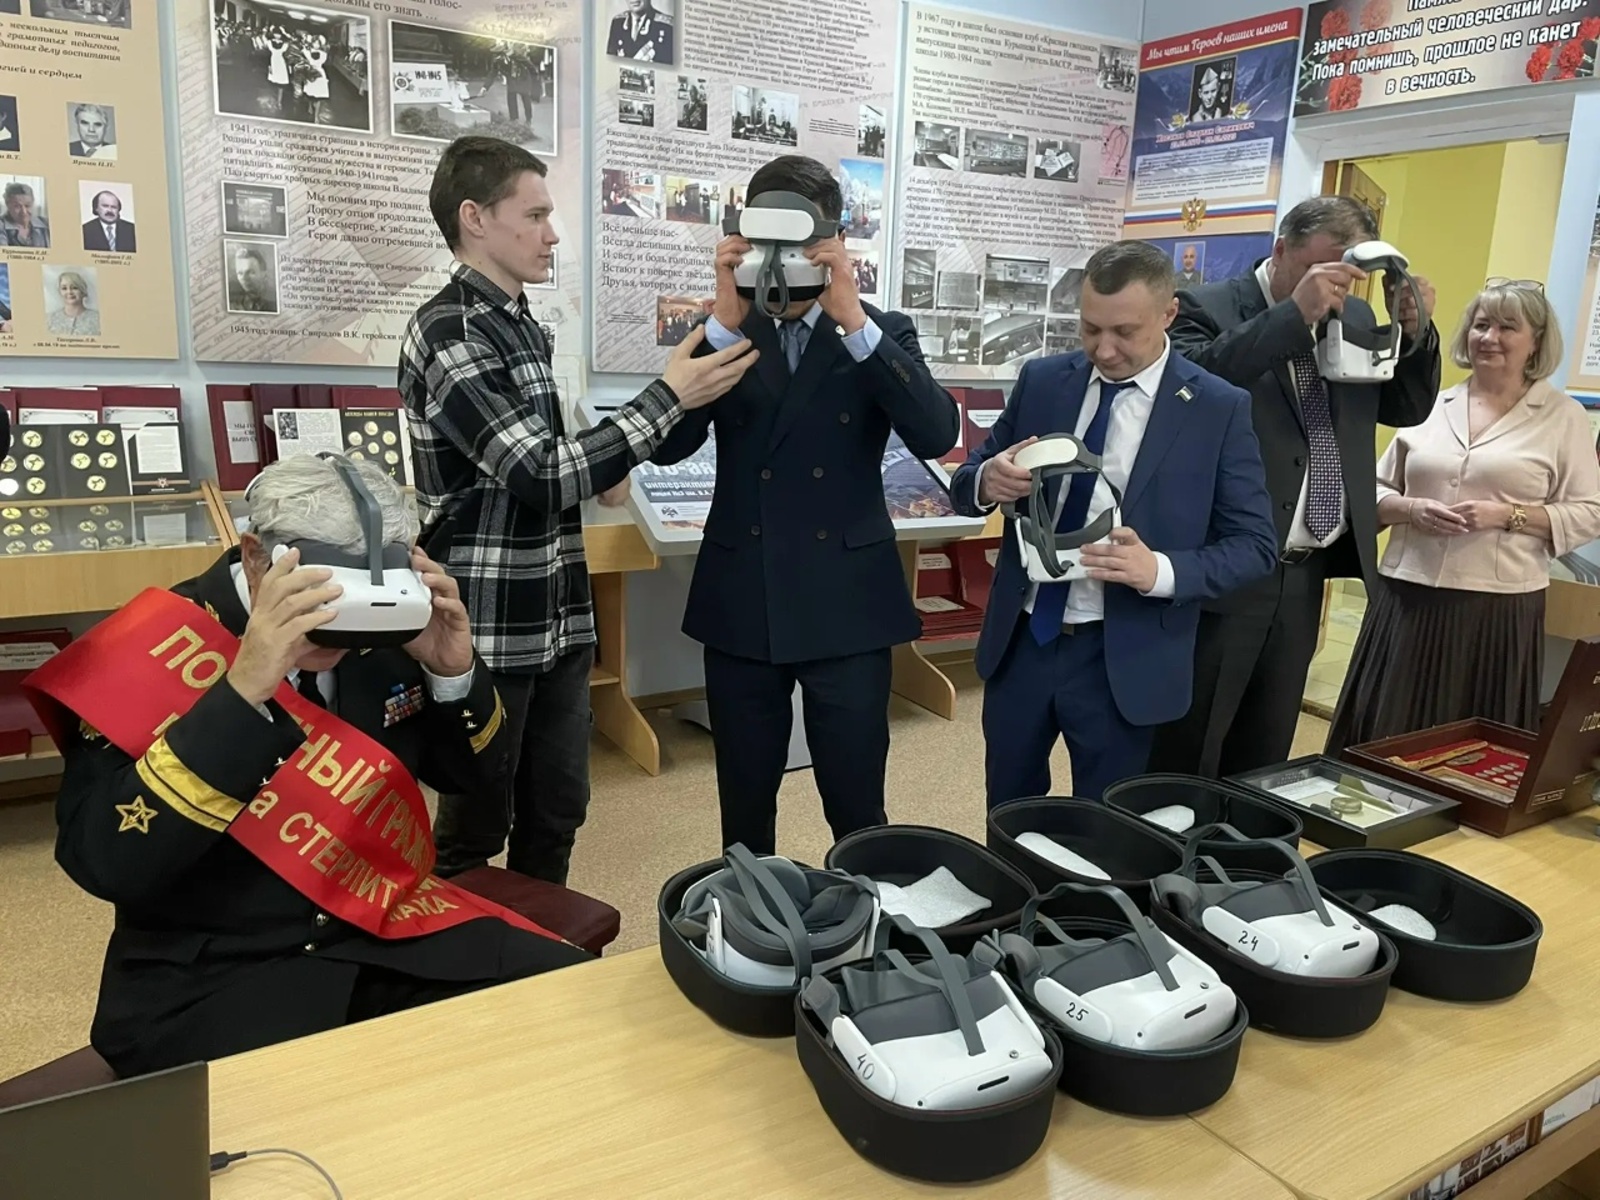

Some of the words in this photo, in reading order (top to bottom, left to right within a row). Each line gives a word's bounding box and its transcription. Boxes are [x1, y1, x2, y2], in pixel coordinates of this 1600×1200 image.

[373, 4, 391, 12] его
[393, 6, 422, 17] знать
[10, 22, 68, 35] нескольким
[1312, 18, 1424, 56] замечательный
[1428, 0, 1542, 33] человеческий
[1546, 0, 1588, 16] дар.
[7, 32, 66, 45] грамотных
[71, 40, 120, 52] педагогов,
[1146, 48, 1163, 61] Мы
[1164, 44, 1190, 57] чтим
[1191, 32, 1223, 54] Героев
[1223, 29, 1255, 44] наших
[1256, 20, 1288, 36] имена
[38, 46, 61, 56] делу
[62, 50, 121, 61] воспитания
[1311, 61, 1345, 81] Пока
[1349, 50, 1419, 74] помнишь,
[1423, 35, 1496, 64] прошлое
[1500, 30, 1523, 50] не
[1527, 21, 1581, 45] канет
[38, 68, 82, 80] сердцем
[1385, 78, 1396, 95] в
[1399, 68, 1475, 93] вечность.
[230, 123, 250, 133] 1941
[306, 191, 325, 201] Мы
[328, 195, 367, 205] помним
[369, 198, 387, 209] про
[390, 201, 424, 213] подвиг,
[306, 204, 344, 217] Дорогу
[346, 209, 374, 219] отцов
[307, 216, 315, 226] В
[318, 218, 378, 233] бессмертие,
[622, 226, 658, 236] меньше
[308, 229, 337, 241] Герои
[340, 235, 368, 243] давно
[602, 236, 635, 247] Всегда
[684, 245, 714, 254] вместе
[602, 249, 610, 259] И
[645, 253, 666, 263] боль
[602, 262, 637, 273] Встают
[602, 275, 637, 288] Друзья,
[639, 280, 676, 291] которых
[686, 284, 709, 292] нами
[1238, 930, 1259, 952] 24
[1066, 1002, 1089, 1021] 25
[857, 1053, 875, 1080] 40
